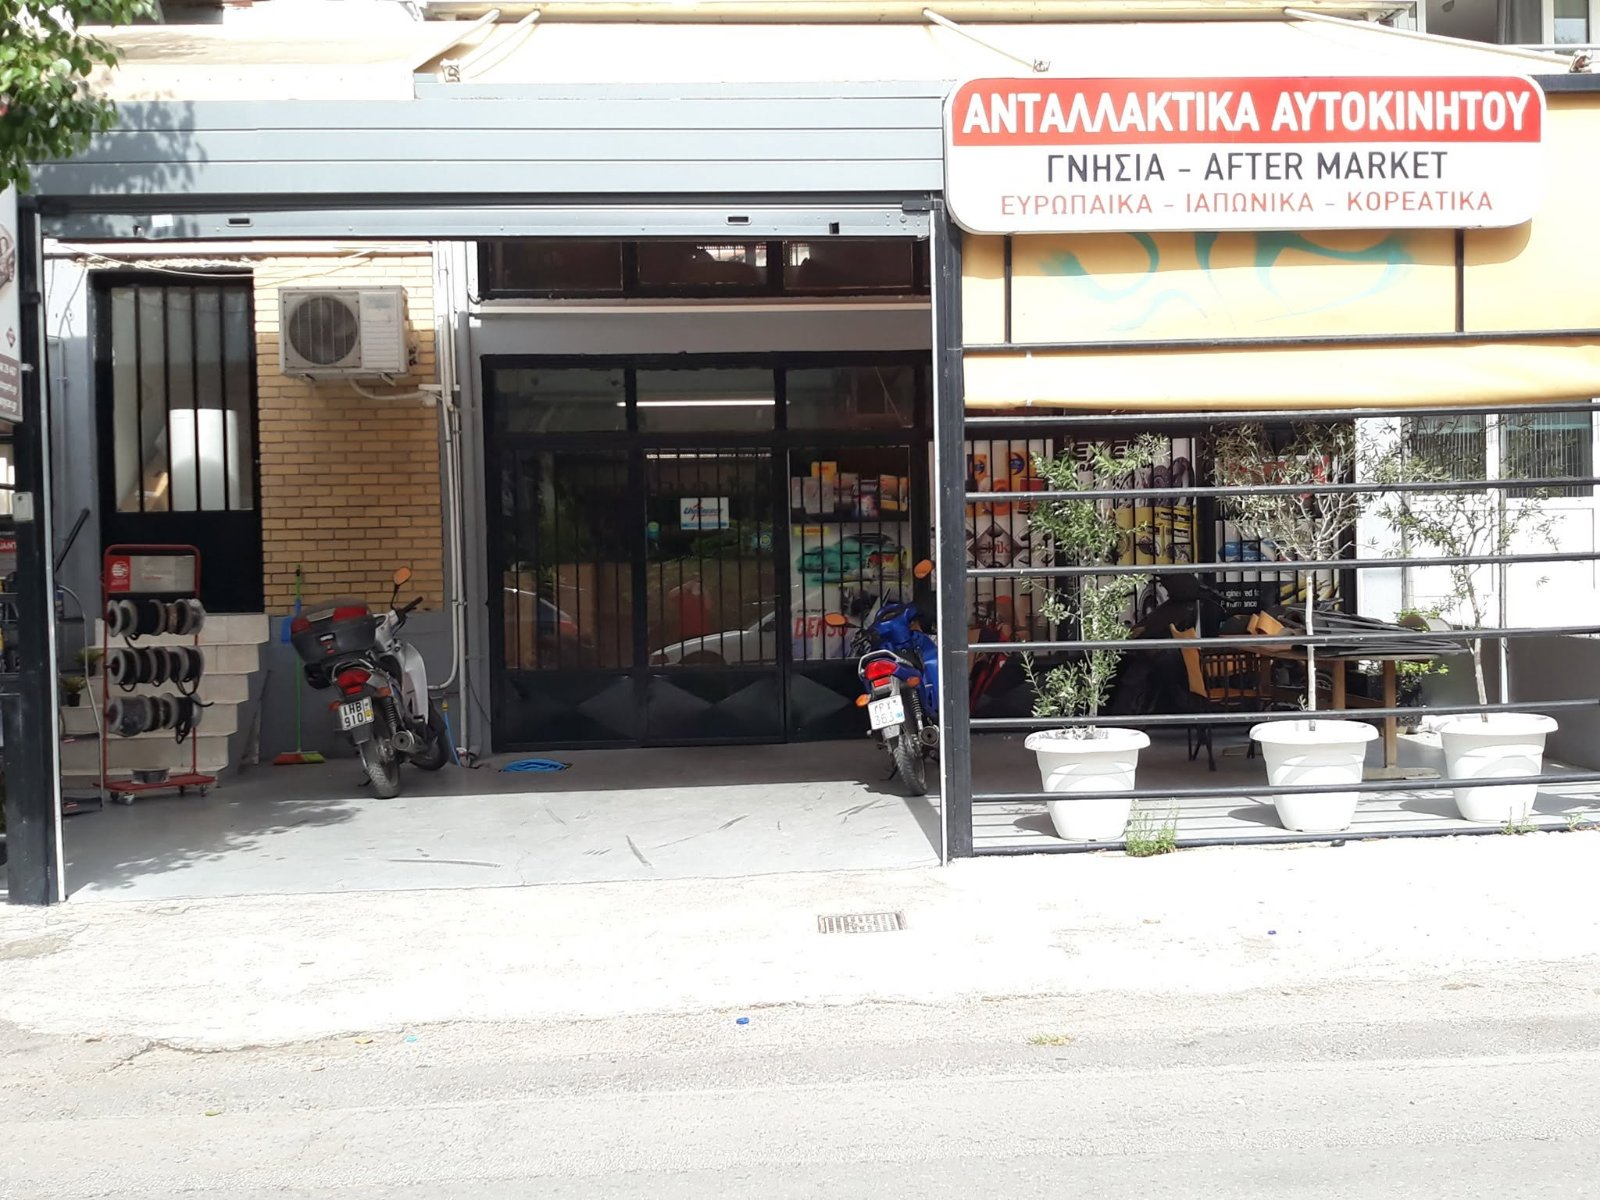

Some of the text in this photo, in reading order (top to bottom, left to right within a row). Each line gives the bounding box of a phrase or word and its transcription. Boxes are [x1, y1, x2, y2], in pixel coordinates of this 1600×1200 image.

[962, 90, 1531, 134] ΑΝΤΑΛΛΑΚΤΙΚΑ ΑΥΤΟΚΙΝΗΤΟΥ
[1047, 153, 1166, 183] ΓΝΗΣΙΑ
[1204, 152, 1303, 181] AFTER
[1317, 151, 1448, 180] MARKET
[1001, 194, 1153, 216] ΕΥΡΩΠΑΙΚΑ
[1186, 192, 1314, 213] ΙΑΠΩΝΙΚΑ
[1347, 191, 1493, 212] ΚΟΡΕΑΤΙΚΑ
[344, 712, 364, 728] 910
